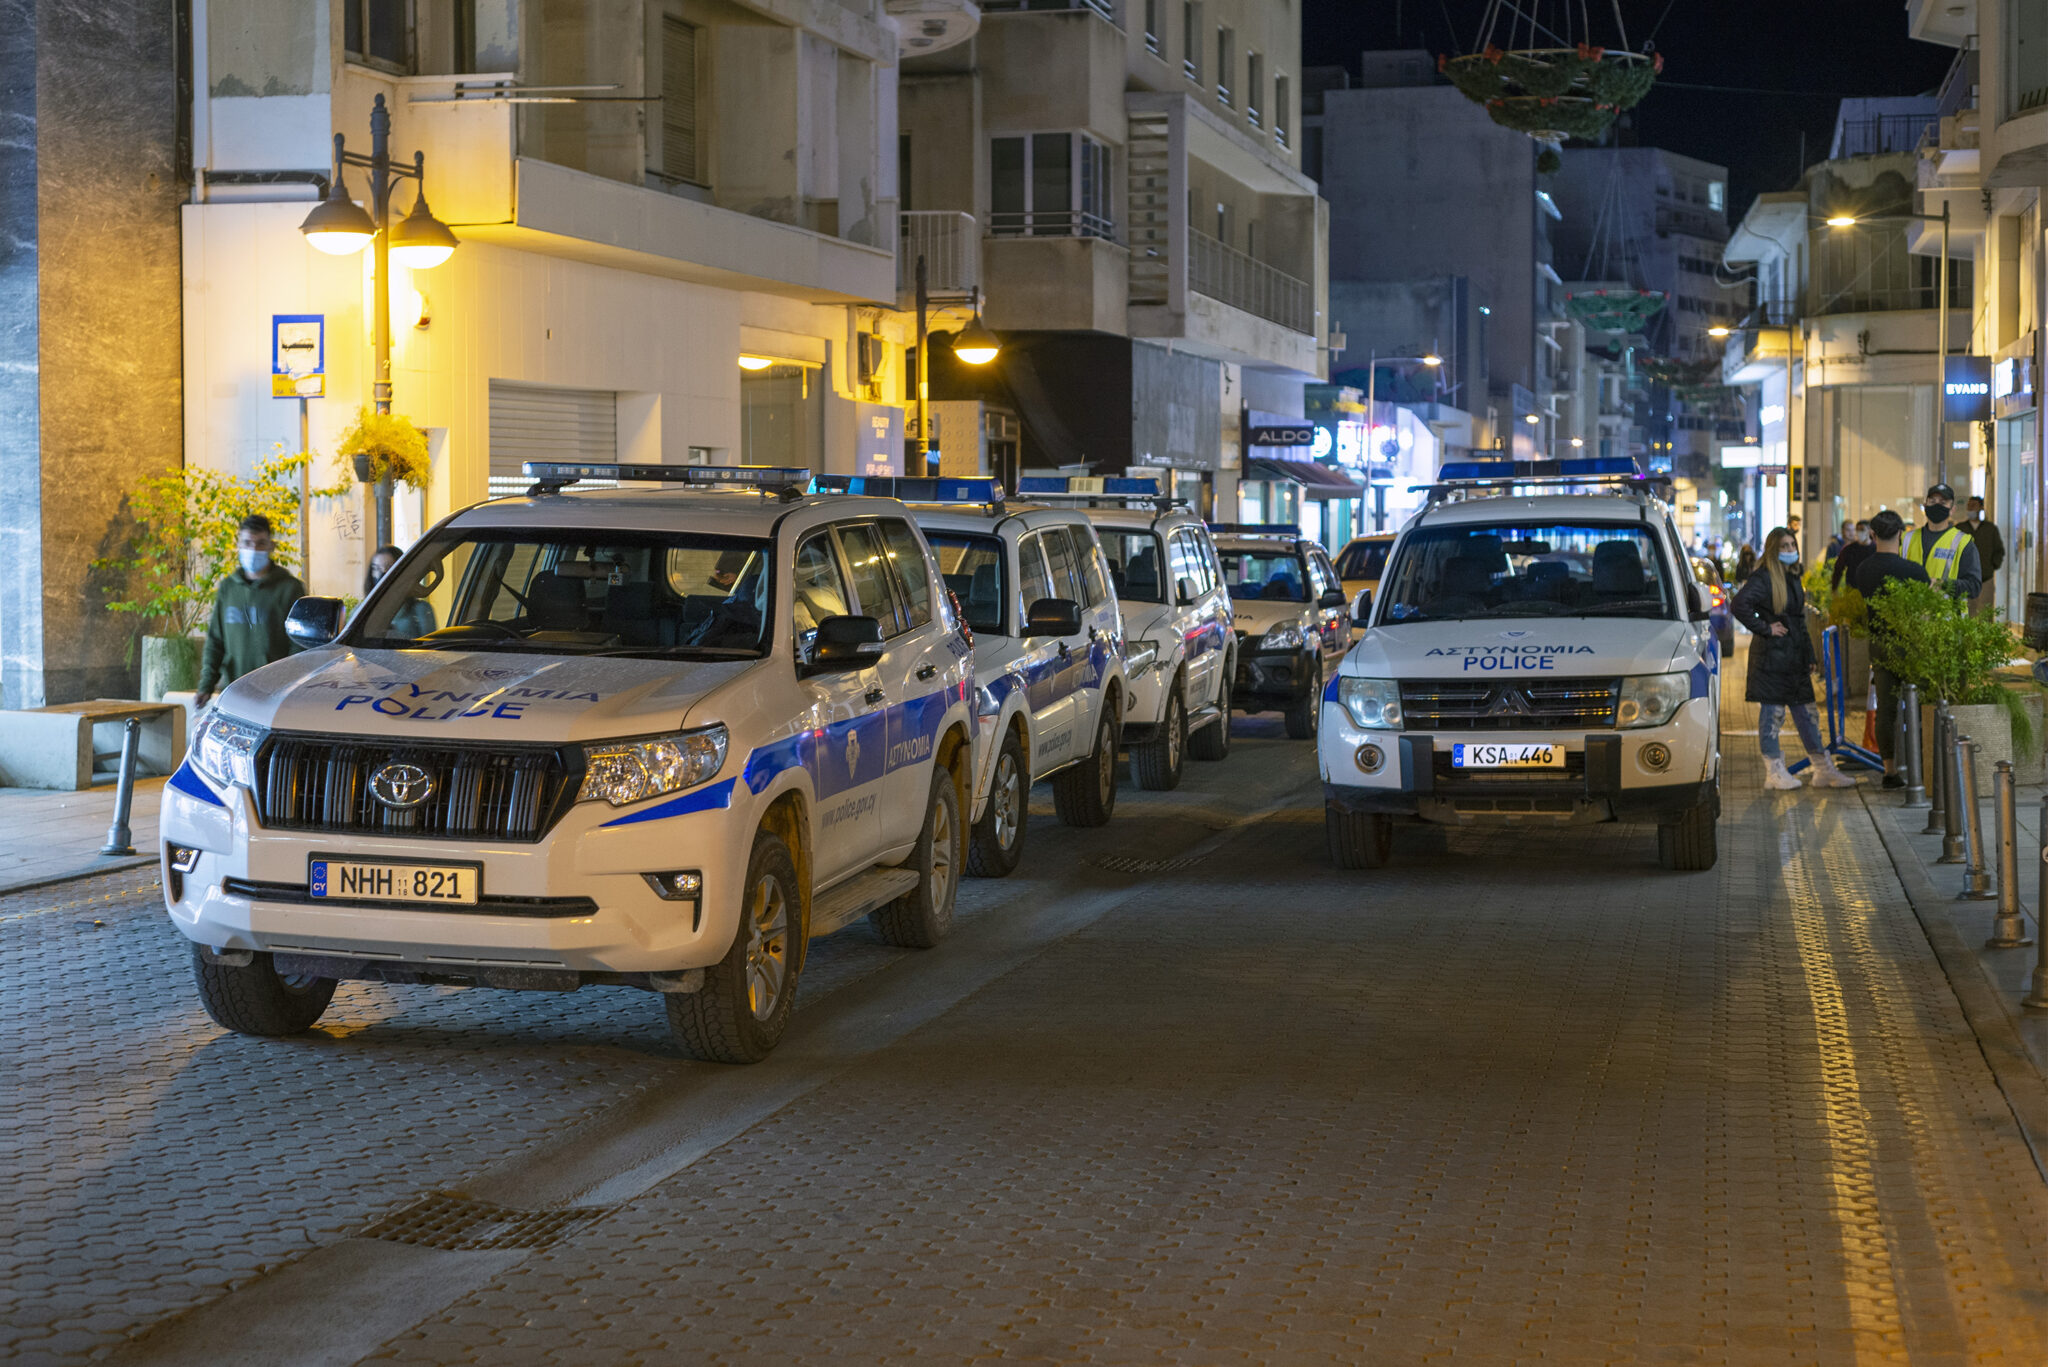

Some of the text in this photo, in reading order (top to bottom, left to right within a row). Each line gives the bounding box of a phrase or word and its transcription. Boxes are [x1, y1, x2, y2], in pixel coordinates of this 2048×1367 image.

[1258, 430, 1311, 442] ALDO
[1425, 646, 1595, 656] ΑΣΤΥΝΟΜΙΑ
[1464, 656, 1554, 671] POLICE
[335, 695, 530, 719] POLICE
[1473, 747, 1552, 764] KSA 446
[313, 883, 326, 891] CY
[341, 867, 461, 898] NHH 821
